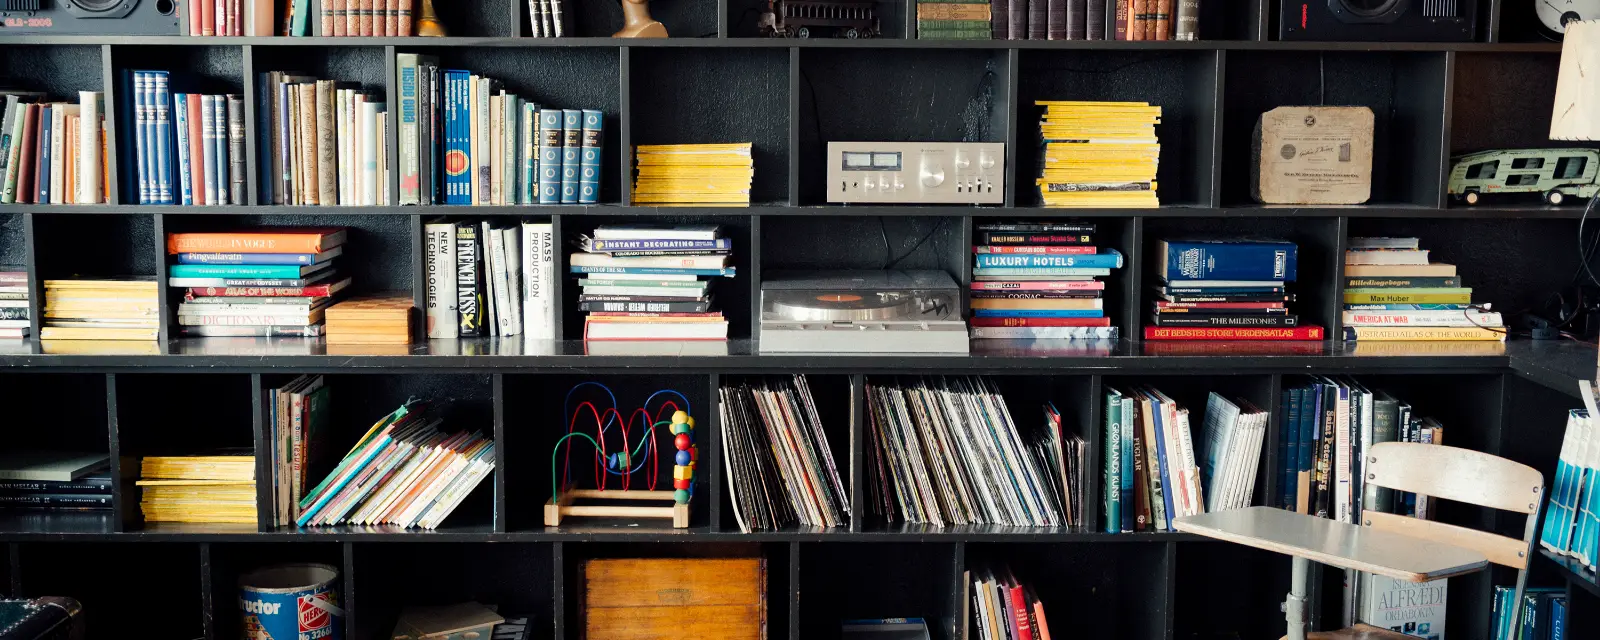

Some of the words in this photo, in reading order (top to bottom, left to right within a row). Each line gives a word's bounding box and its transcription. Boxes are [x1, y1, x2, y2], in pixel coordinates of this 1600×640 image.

[231, 239, 241, 249] IN
[243, 239, 276, 249] VOGUE
[428, 231, 437, 309] TECHNOLOGIES
[458, 239, 476, 286] FRENCH
[531, 231, 540, 299] PRODUCTION
[985, 256, 1029, 266] LUXURY
[1033, 256, 1075, 266] HOTELS
[225, 288, 247, 296] ATLAS
[248, 288, 260, 296] OF
[261, 288, 274, 296] THE
[275, 288, 303, 296] WORLD
[458, 286, 476, 314] KISS
[202, 315, 277, 325] DICTIONARY
[1154, 329, 1170, 337] DET
[1171, 329, 1206, 337] BEDSTES
[1207, 329, 1233, 337] STORE
[1234, 329, 1294, 337] VERDENSATLAS
[1210, 317, 1227, 325] THE
[1228, 317, 1277, 325] MILESTONES
[1353, 315, 1382, 323] AMERICA
[1383, 315, 1392, 323] AT
[1393, 315, 1409, 323] WAR
[1324, 409, 1334, 436] Saint
[1111, 422, 1120, 474] GRØNLANDS
[1133, 437, 1142, 471] FUGLAR
[1181, 421, 1193, 467] REFLECTIONS
[1319, 436, 1333, 491] Petersburg
[1111, 475, 1120, 503] KUNST
